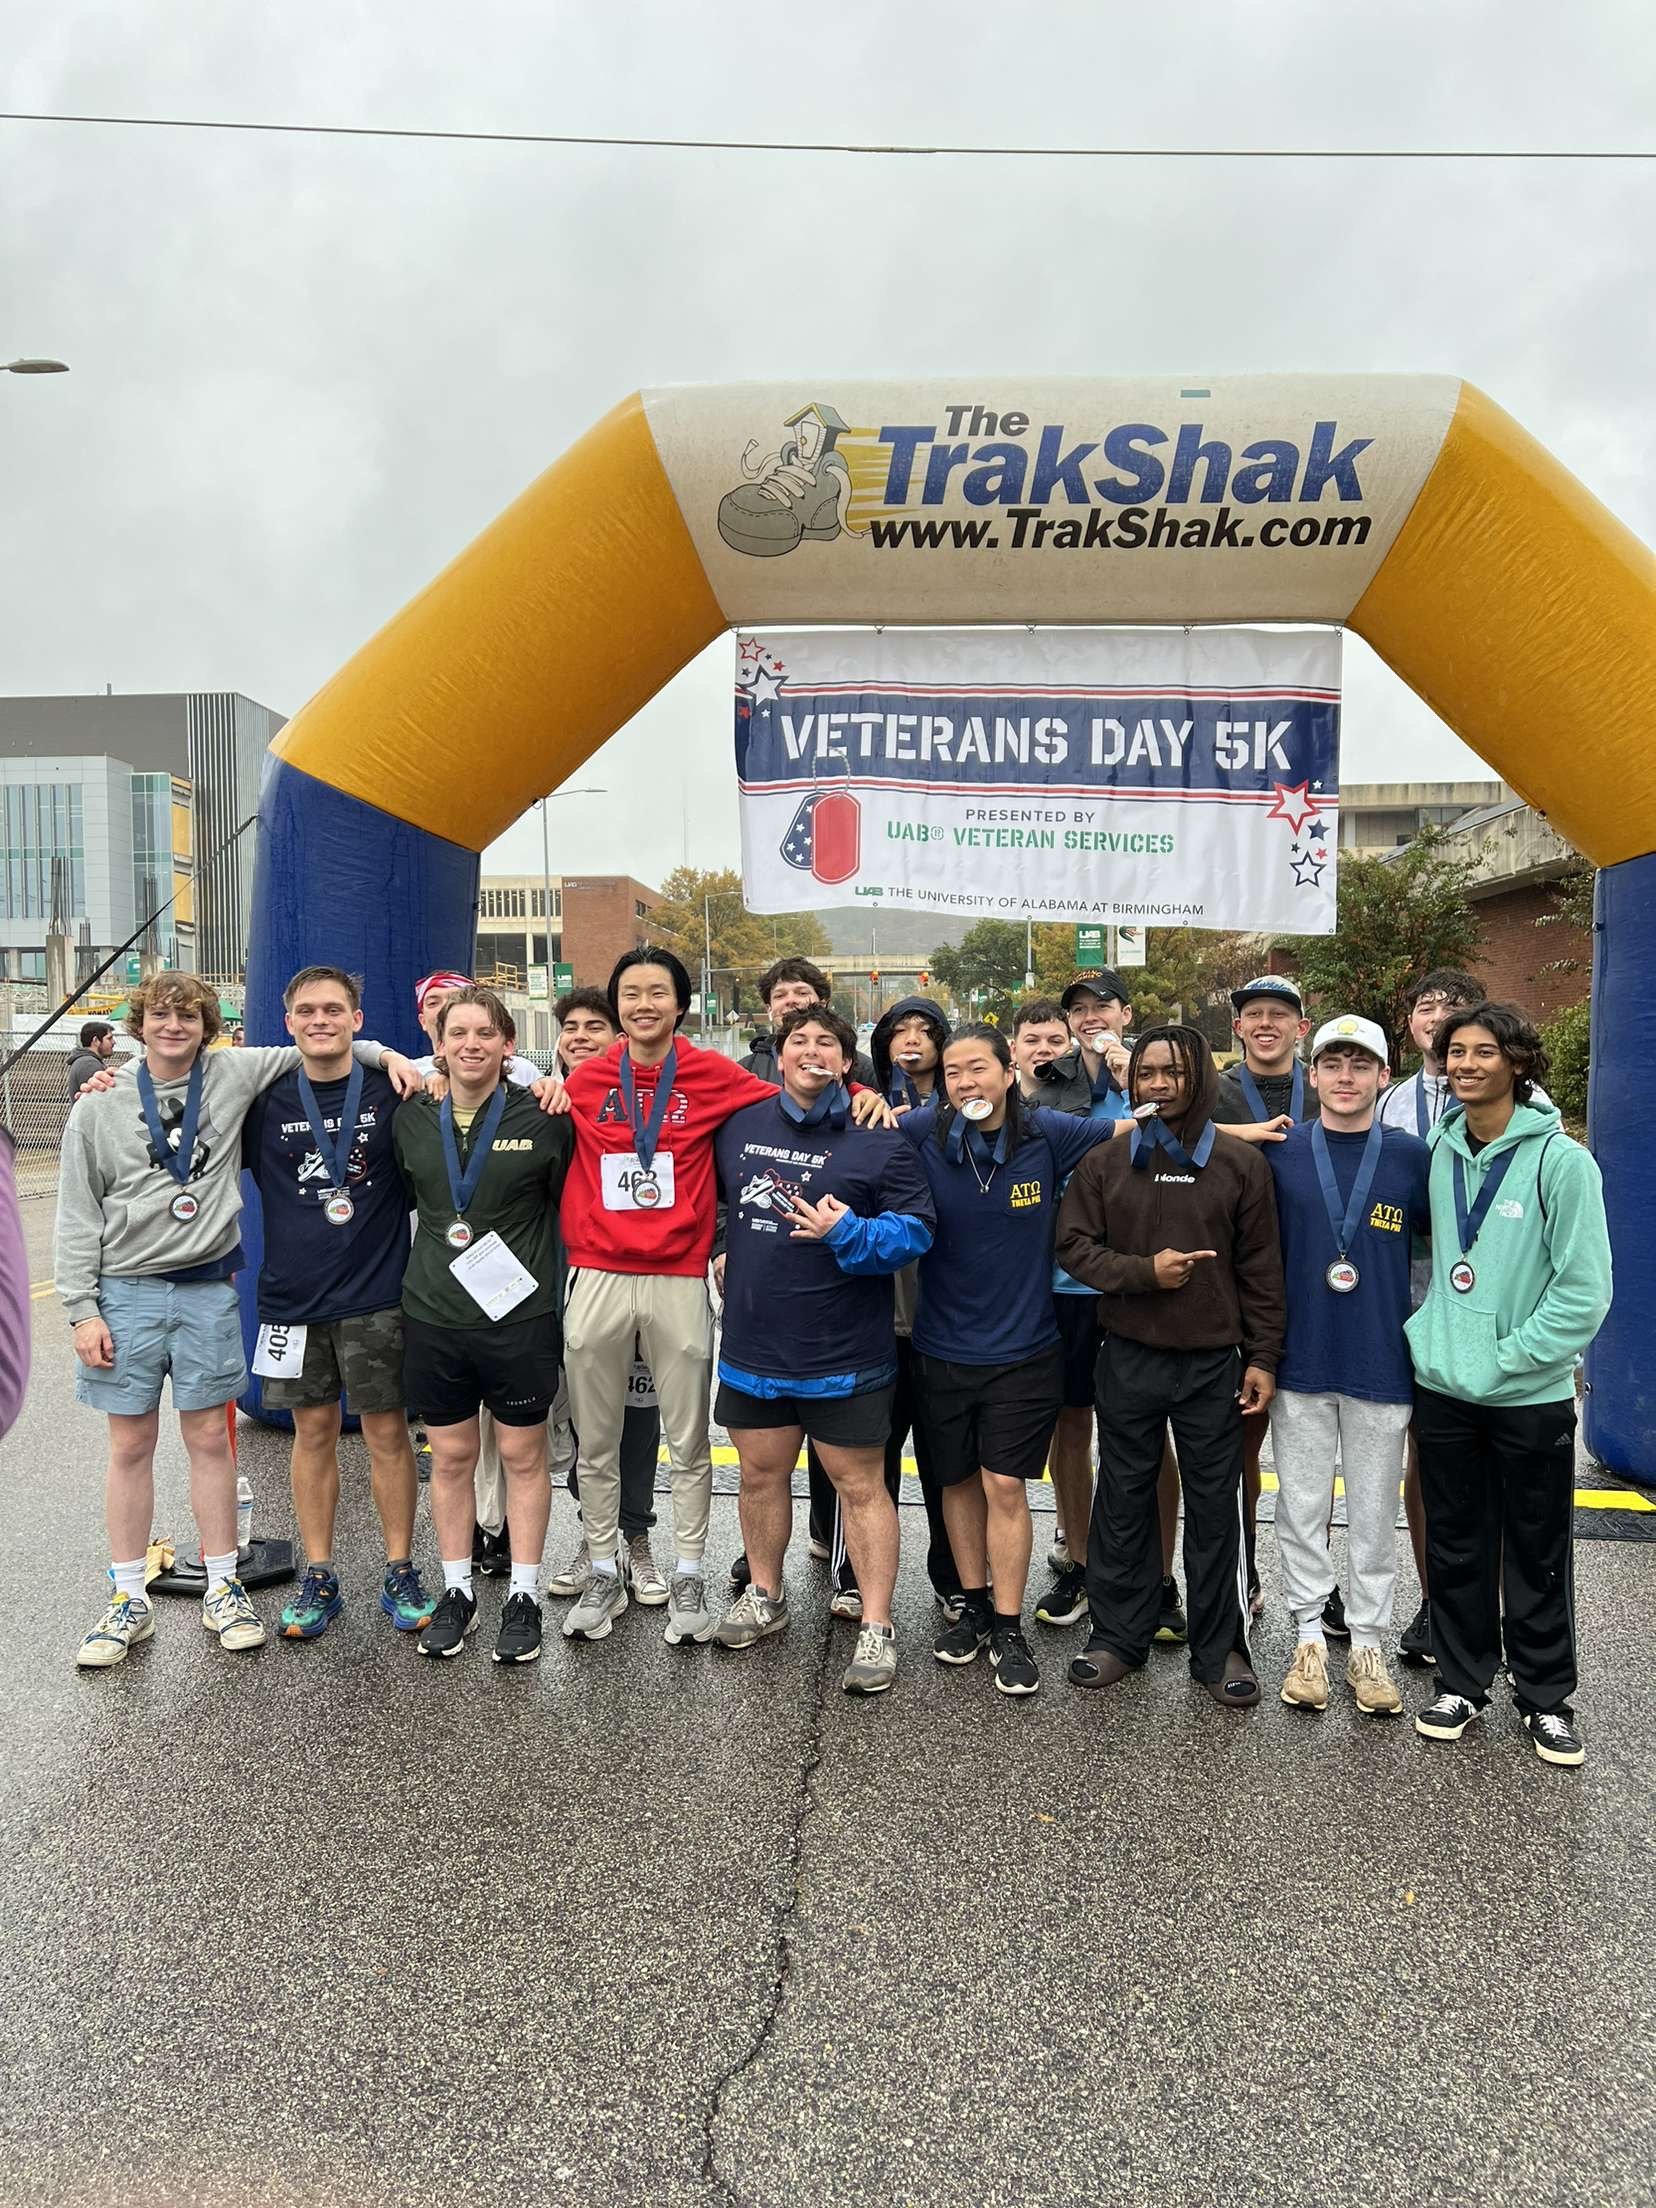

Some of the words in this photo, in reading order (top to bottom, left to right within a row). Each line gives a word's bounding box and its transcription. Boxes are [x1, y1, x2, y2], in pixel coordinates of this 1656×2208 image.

[945, 405, 1030, 437] The
[879, 421, 1376, 505] TrakShak
[871, 506, 1372, 550] www.TrakShak.com
[780, 712, 1069, 764] VETERANS
[1091, 718, 1194, 767] DAY
[1215, 720, 1293, 770] 5K
[965, 808, 1066, 823] PRESENTED
[1073, 811, 1096, 824] BY
[953, 827, 1055, 849] VETERAN
[1063, 829, 1175, 854] SERVICES
[855, 886, 884, 896] UAB
[888, 887, 913, 898] THE
[918, 889, 994, 907] UNIVERSITY
[998, 897, 1018, 908] OF
[1021, 898, 1088, 912] ALABAMA
[1092, 902, 1109, 913] AT
[1112, 903, 1204, 916] BIRMINGHAM
[1079, 930, 1102, 939] UAB
[491, 1138, 534, 1151] UAB
[744, 1143, 791, 1160] VETERANS
[791, 1150, 812, 1164] DAY
